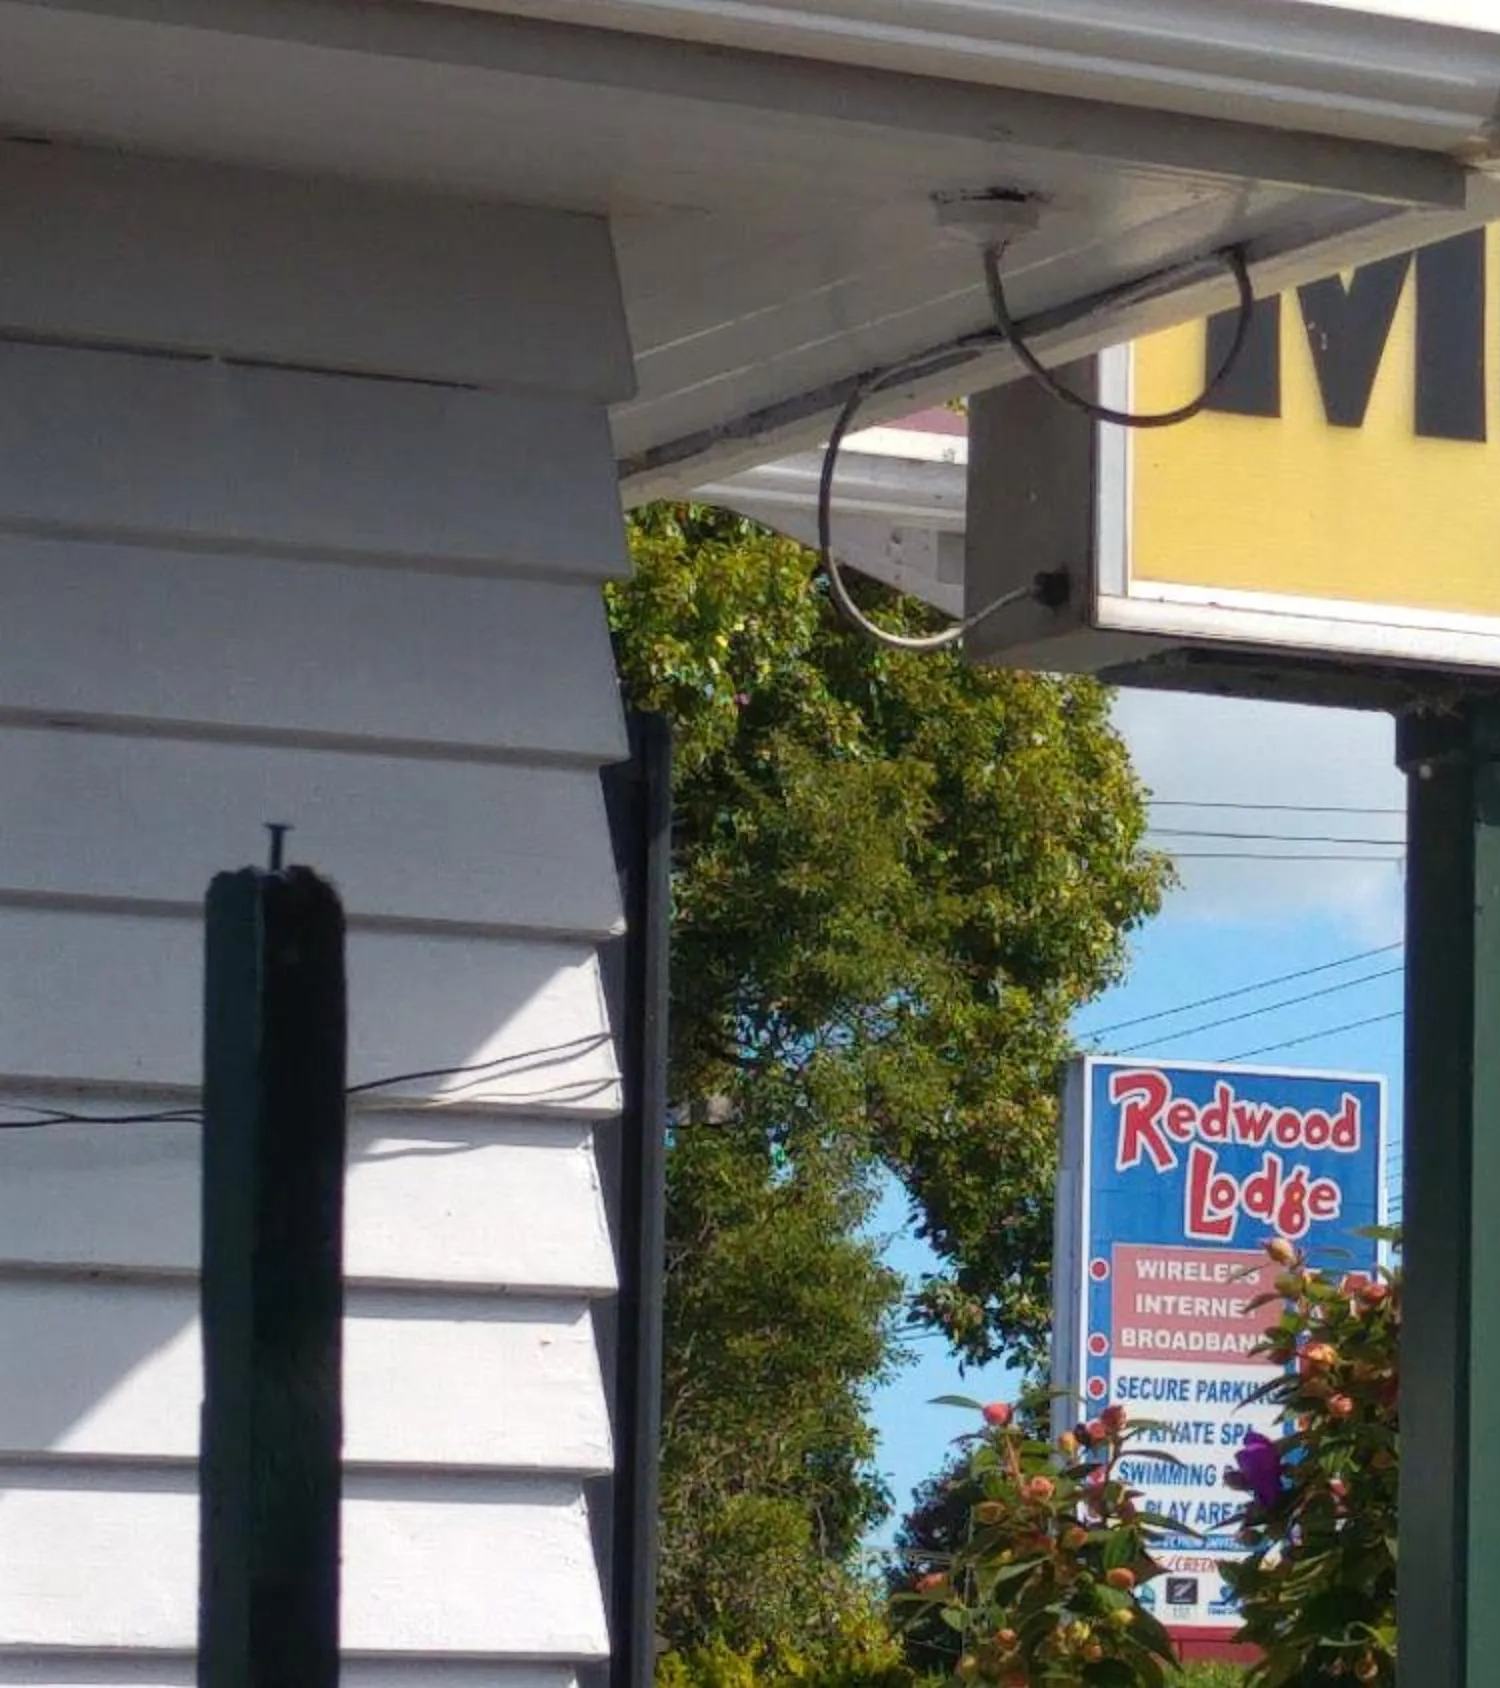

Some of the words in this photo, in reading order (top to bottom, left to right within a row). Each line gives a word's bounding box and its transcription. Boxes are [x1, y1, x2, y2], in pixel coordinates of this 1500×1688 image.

[1109, 1069, 1362, 1172] Redwood
[1185, 1142, 1341, 1240] Lodge
[1116, 1375, 1191, 1401] SECURE
[1195, 1378, 1284, 1405] PARKI
[1219, 1421, 1257, 1447] SP
[1118, 1459, 1217, 1487] SWIMMING
